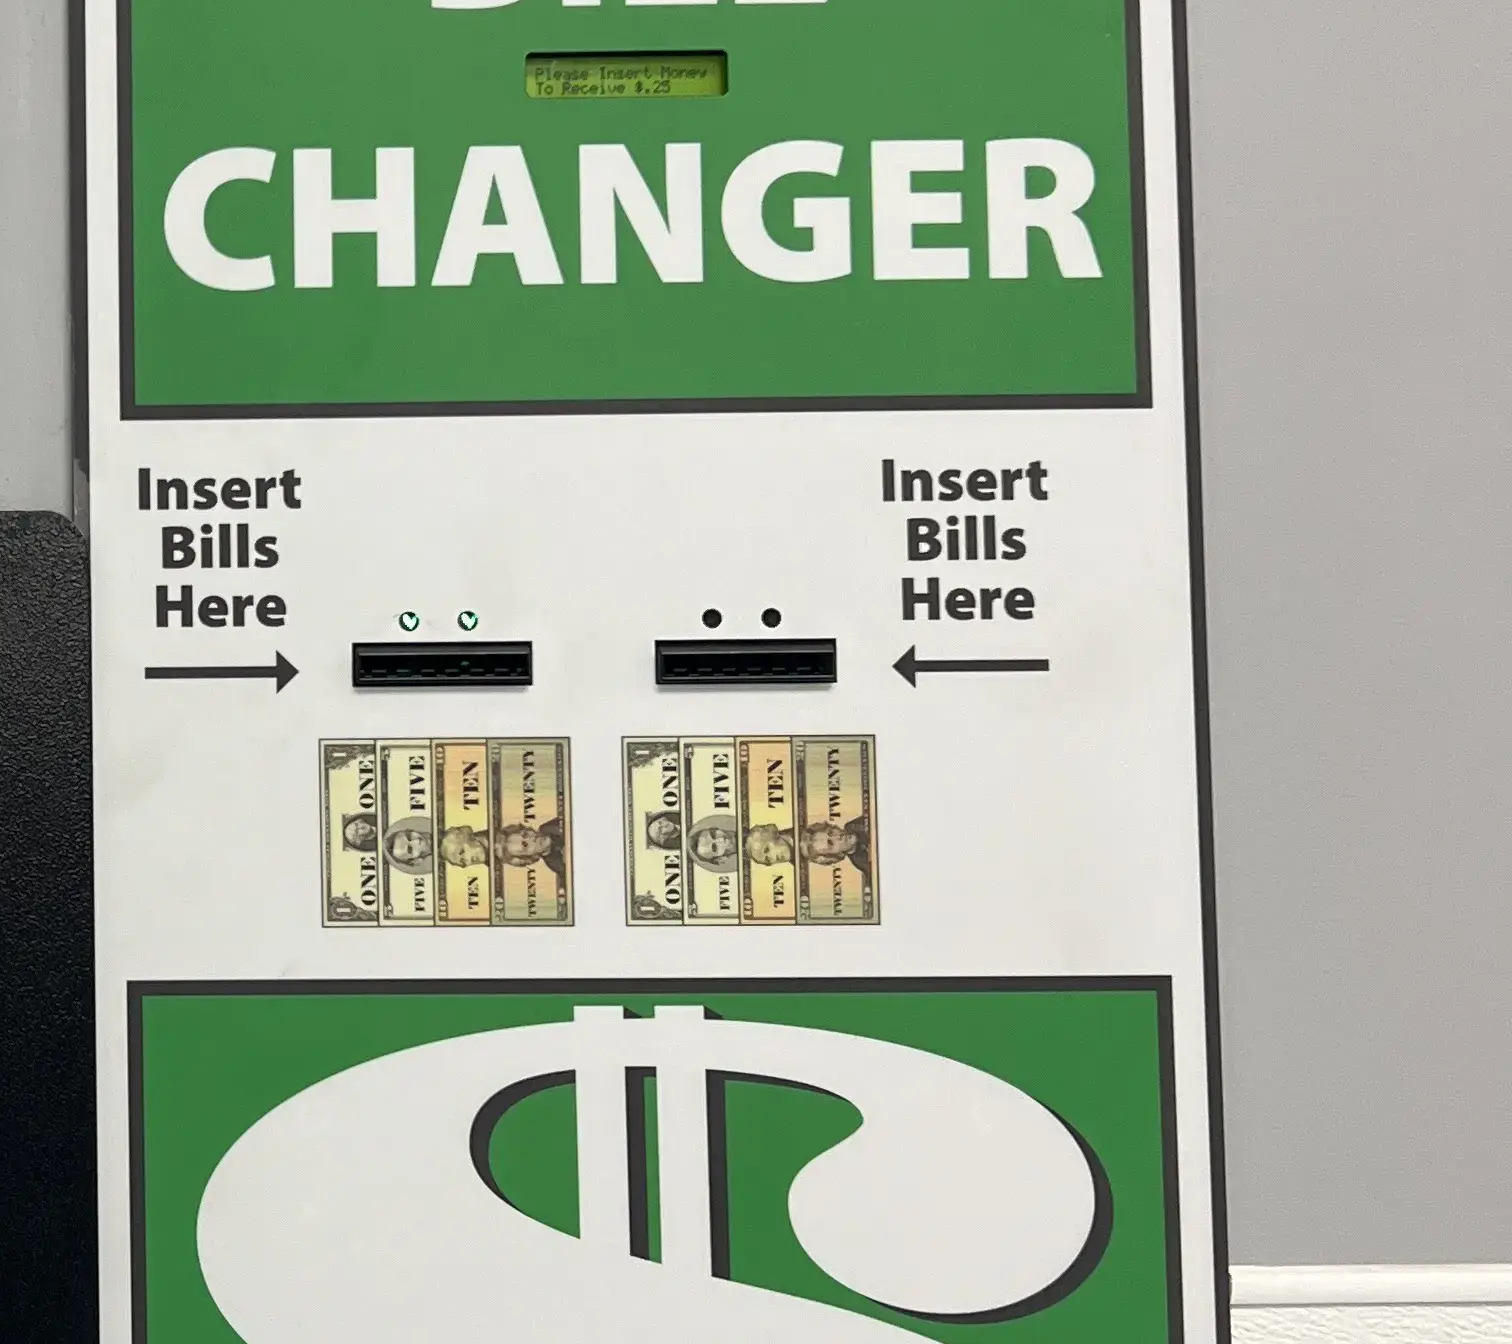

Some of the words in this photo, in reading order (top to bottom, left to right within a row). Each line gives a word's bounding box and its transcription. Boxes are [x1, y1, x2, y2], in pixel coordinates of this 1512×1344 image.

[535, 67, 588, 81] Please
[600, 66, 652, 79] Insert
[660, 66, 707, 78] Money
[535, 83, 554, 96] To
[562, 81, 625, 95] Receive
[163, 138, 1103, 291] CHANGER
[138, 467, 302, 511] Insert
[881, 458, 1049, 502] Insert
[161, 523, 279, 569] Bills
[906, 514, 1026, 561] Bills
[155, 584, 286, 628] Here
[901, 577, 1035, 621] Here
[359, 760, 375, 809] ONE
[409, 756, 426, 811] FIVE
[462, 760, 480, 811] TEN
[523, 748, 536, 823] TWENTY
[662, 757, 678, 808] ONE
[713, 753, 730, 809] FIVE
[767, 758, 785, 809] TEN
[827, 746, 841, 821] TWENTY
[360, 856, 376, 906] ONE
[414, 877, 425, 912] FIVE
[468, 876, 479, 910] TEN
[527, 866, 537, 918] TWENTY
[665, 855, 680, 905] ONE
[719, 876, 730, 911] FIVE
[773, 875, 785, 908] TEN
[833, 867, 842, 916] TWENTY
